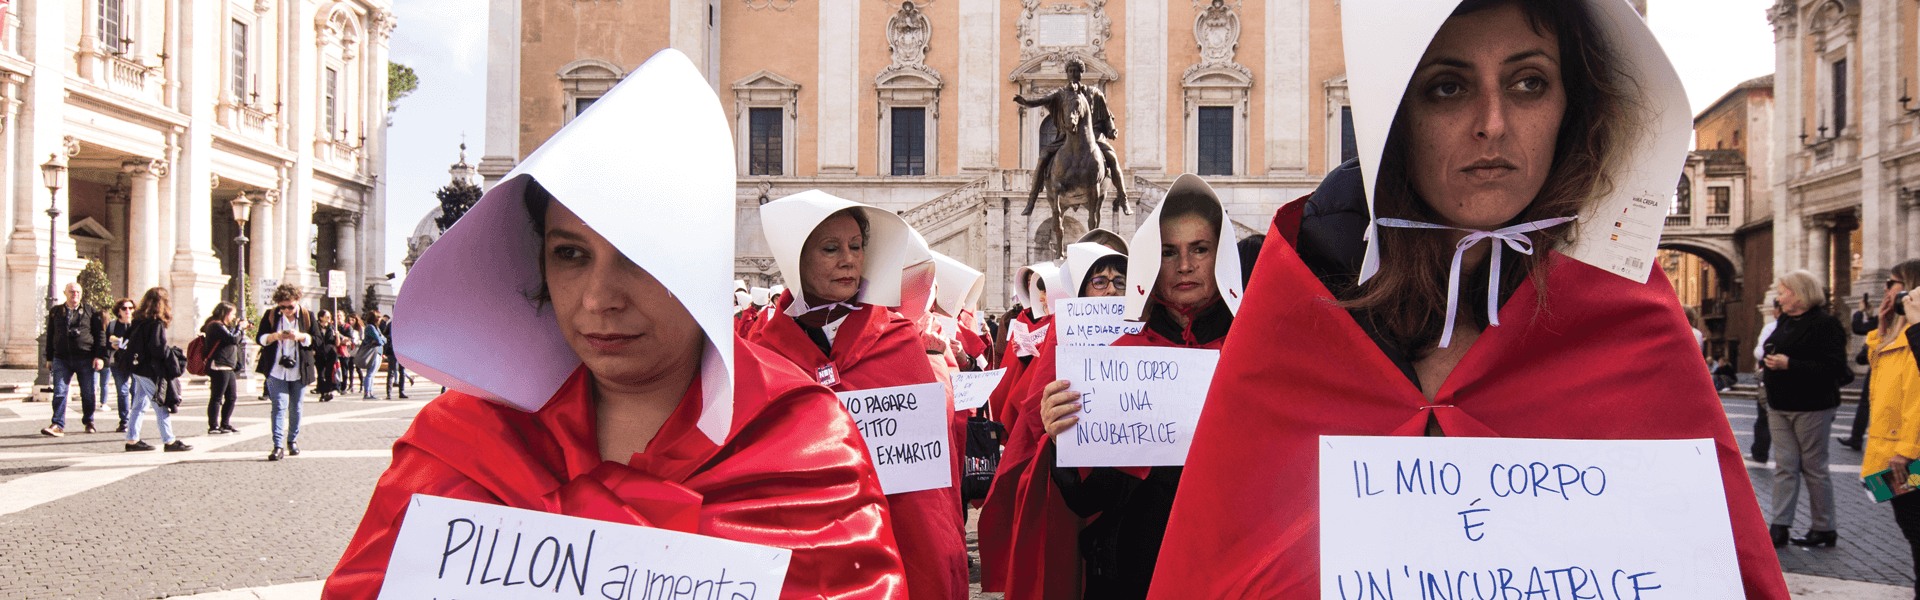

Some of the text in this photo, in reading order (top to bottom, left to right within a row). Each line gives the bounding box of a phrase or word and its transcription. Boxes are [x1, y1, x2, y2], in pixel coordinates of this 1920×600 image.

[1077, 324, 1121, 340] MEDIARE
[1084, 358, 1179, 381] IL MIO CORPO
[1120, 389, 1153, 412] UNA
[1076, 421, 1176, 446] INCUBATRICE
[876, 440, 941, 466] EX-MARITO
[1353, 458, 1607, 500] IL MIO CORPO
[1457, 498, 1491, 542] É
[438, 518, 597, 596] PILLON
